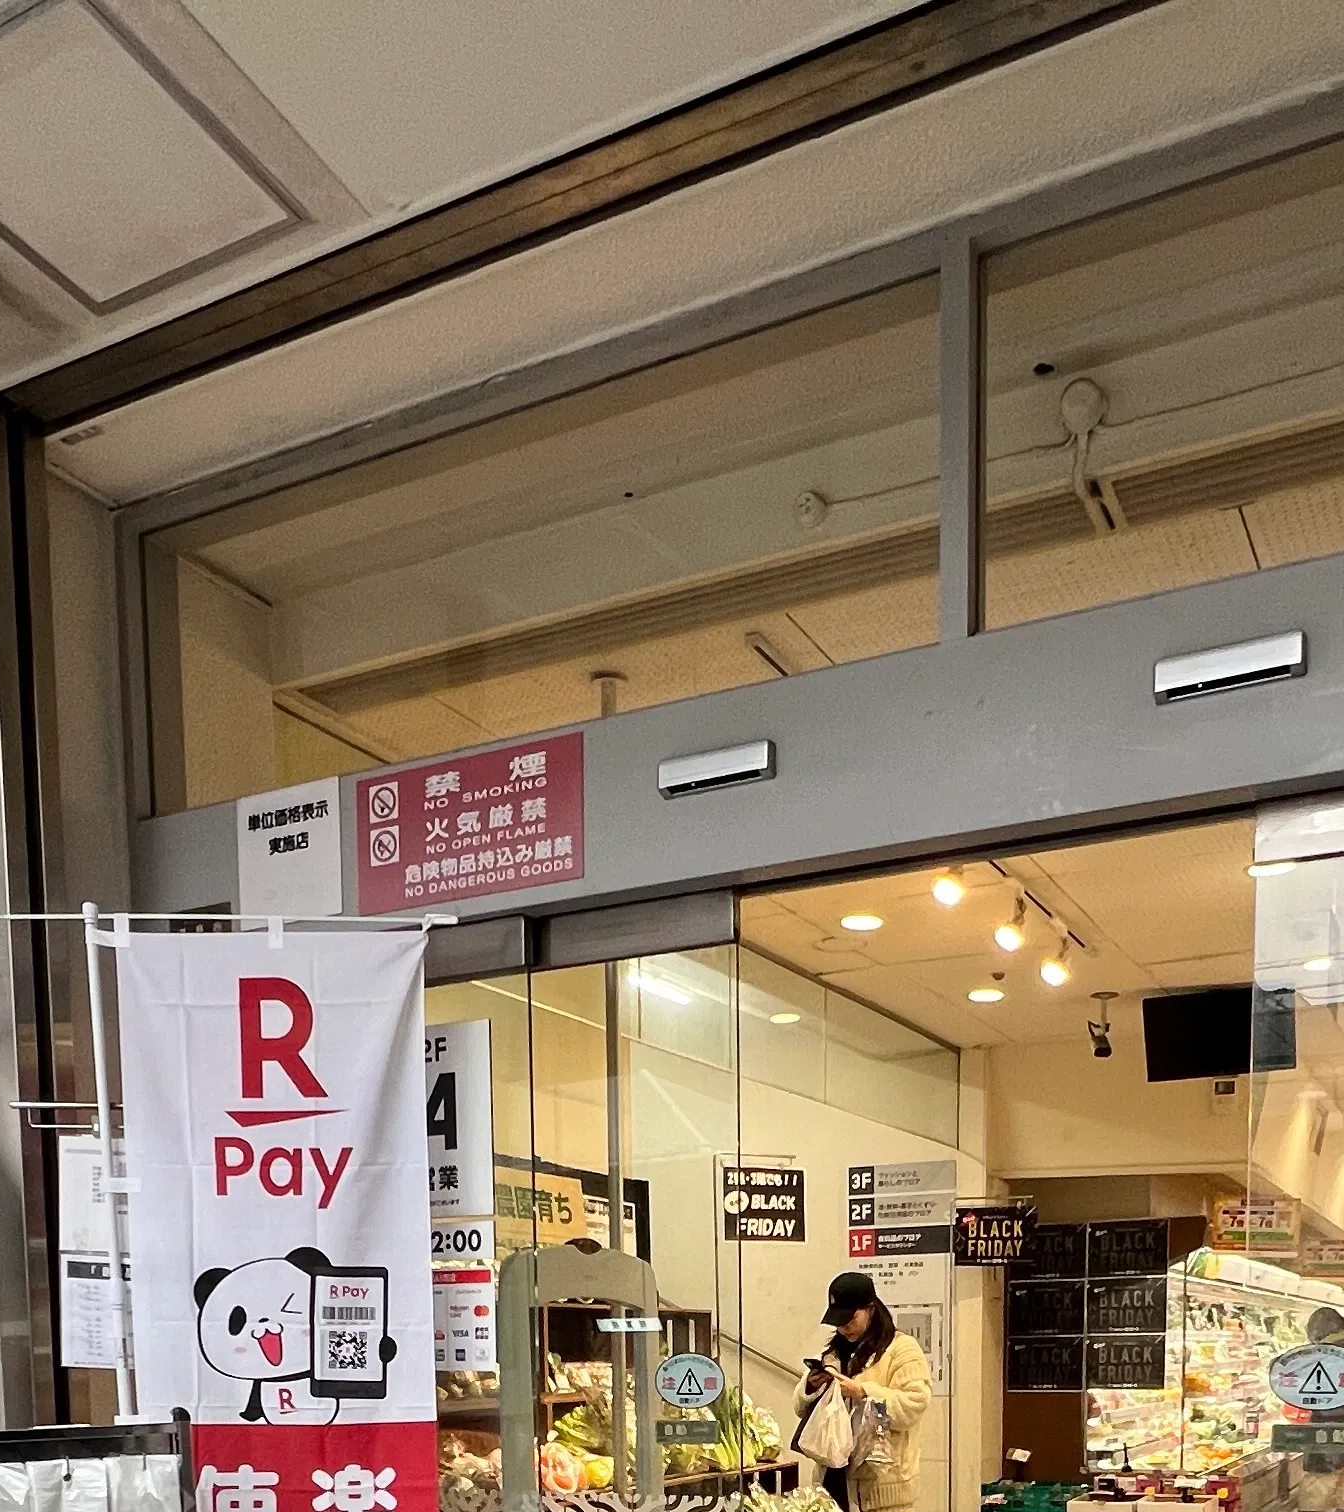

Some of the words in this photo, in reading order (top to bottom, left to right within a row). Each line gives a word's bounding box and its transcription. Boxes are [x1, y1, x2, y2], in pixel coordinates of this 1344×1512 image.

[424, 797, 449, 811] NO
[462, 777, 547, 803] SMOKING
[248, 800, 329, 832] 単位価格表示
[425, 797, 547, 842] 火気厳禁
[269, 832, 309, 856] 実施店
[426, 843, 447, 855] NO
[452, 834, 492, 851] OPEN
[496, 824, 546, 842] FLAME
[405, 836, 573, 885] 危険物品持込み厳禁
[405, 885, 424, 898] NO
[429, 869, 515, 896] DANGEROUS
[520, 858, 574, 878] GOODS
[239, 977, 329, 1098] R
[214, 1137, 353, 1209] Pay
[852, 1173, 871, 1190] 3F
[751, 1194, 796, 1211] BLACK
[851, 1204, 872, 1221] 2F
[737, 1218, 796, 1238] FRIDAY
[968, 1220, 1023, 1238] BLACK
[852, 1235, 872, 1252] 1F
[967, 1240, 1023, 1257] FRIDAY
[1101, 1232, 1156, 1251] BLACK
[343, 1284, 369, 1299] Pay
[1099, 1290, 1154, 1308] BLACK
[1099, 1308, 1154, 1326] FRIDAY
[1098, 1347, 1153, 1364] BLACK
[1098, 1365, 1153, 1382] FRIDAY
[278, 1388, 296, 1411] R
